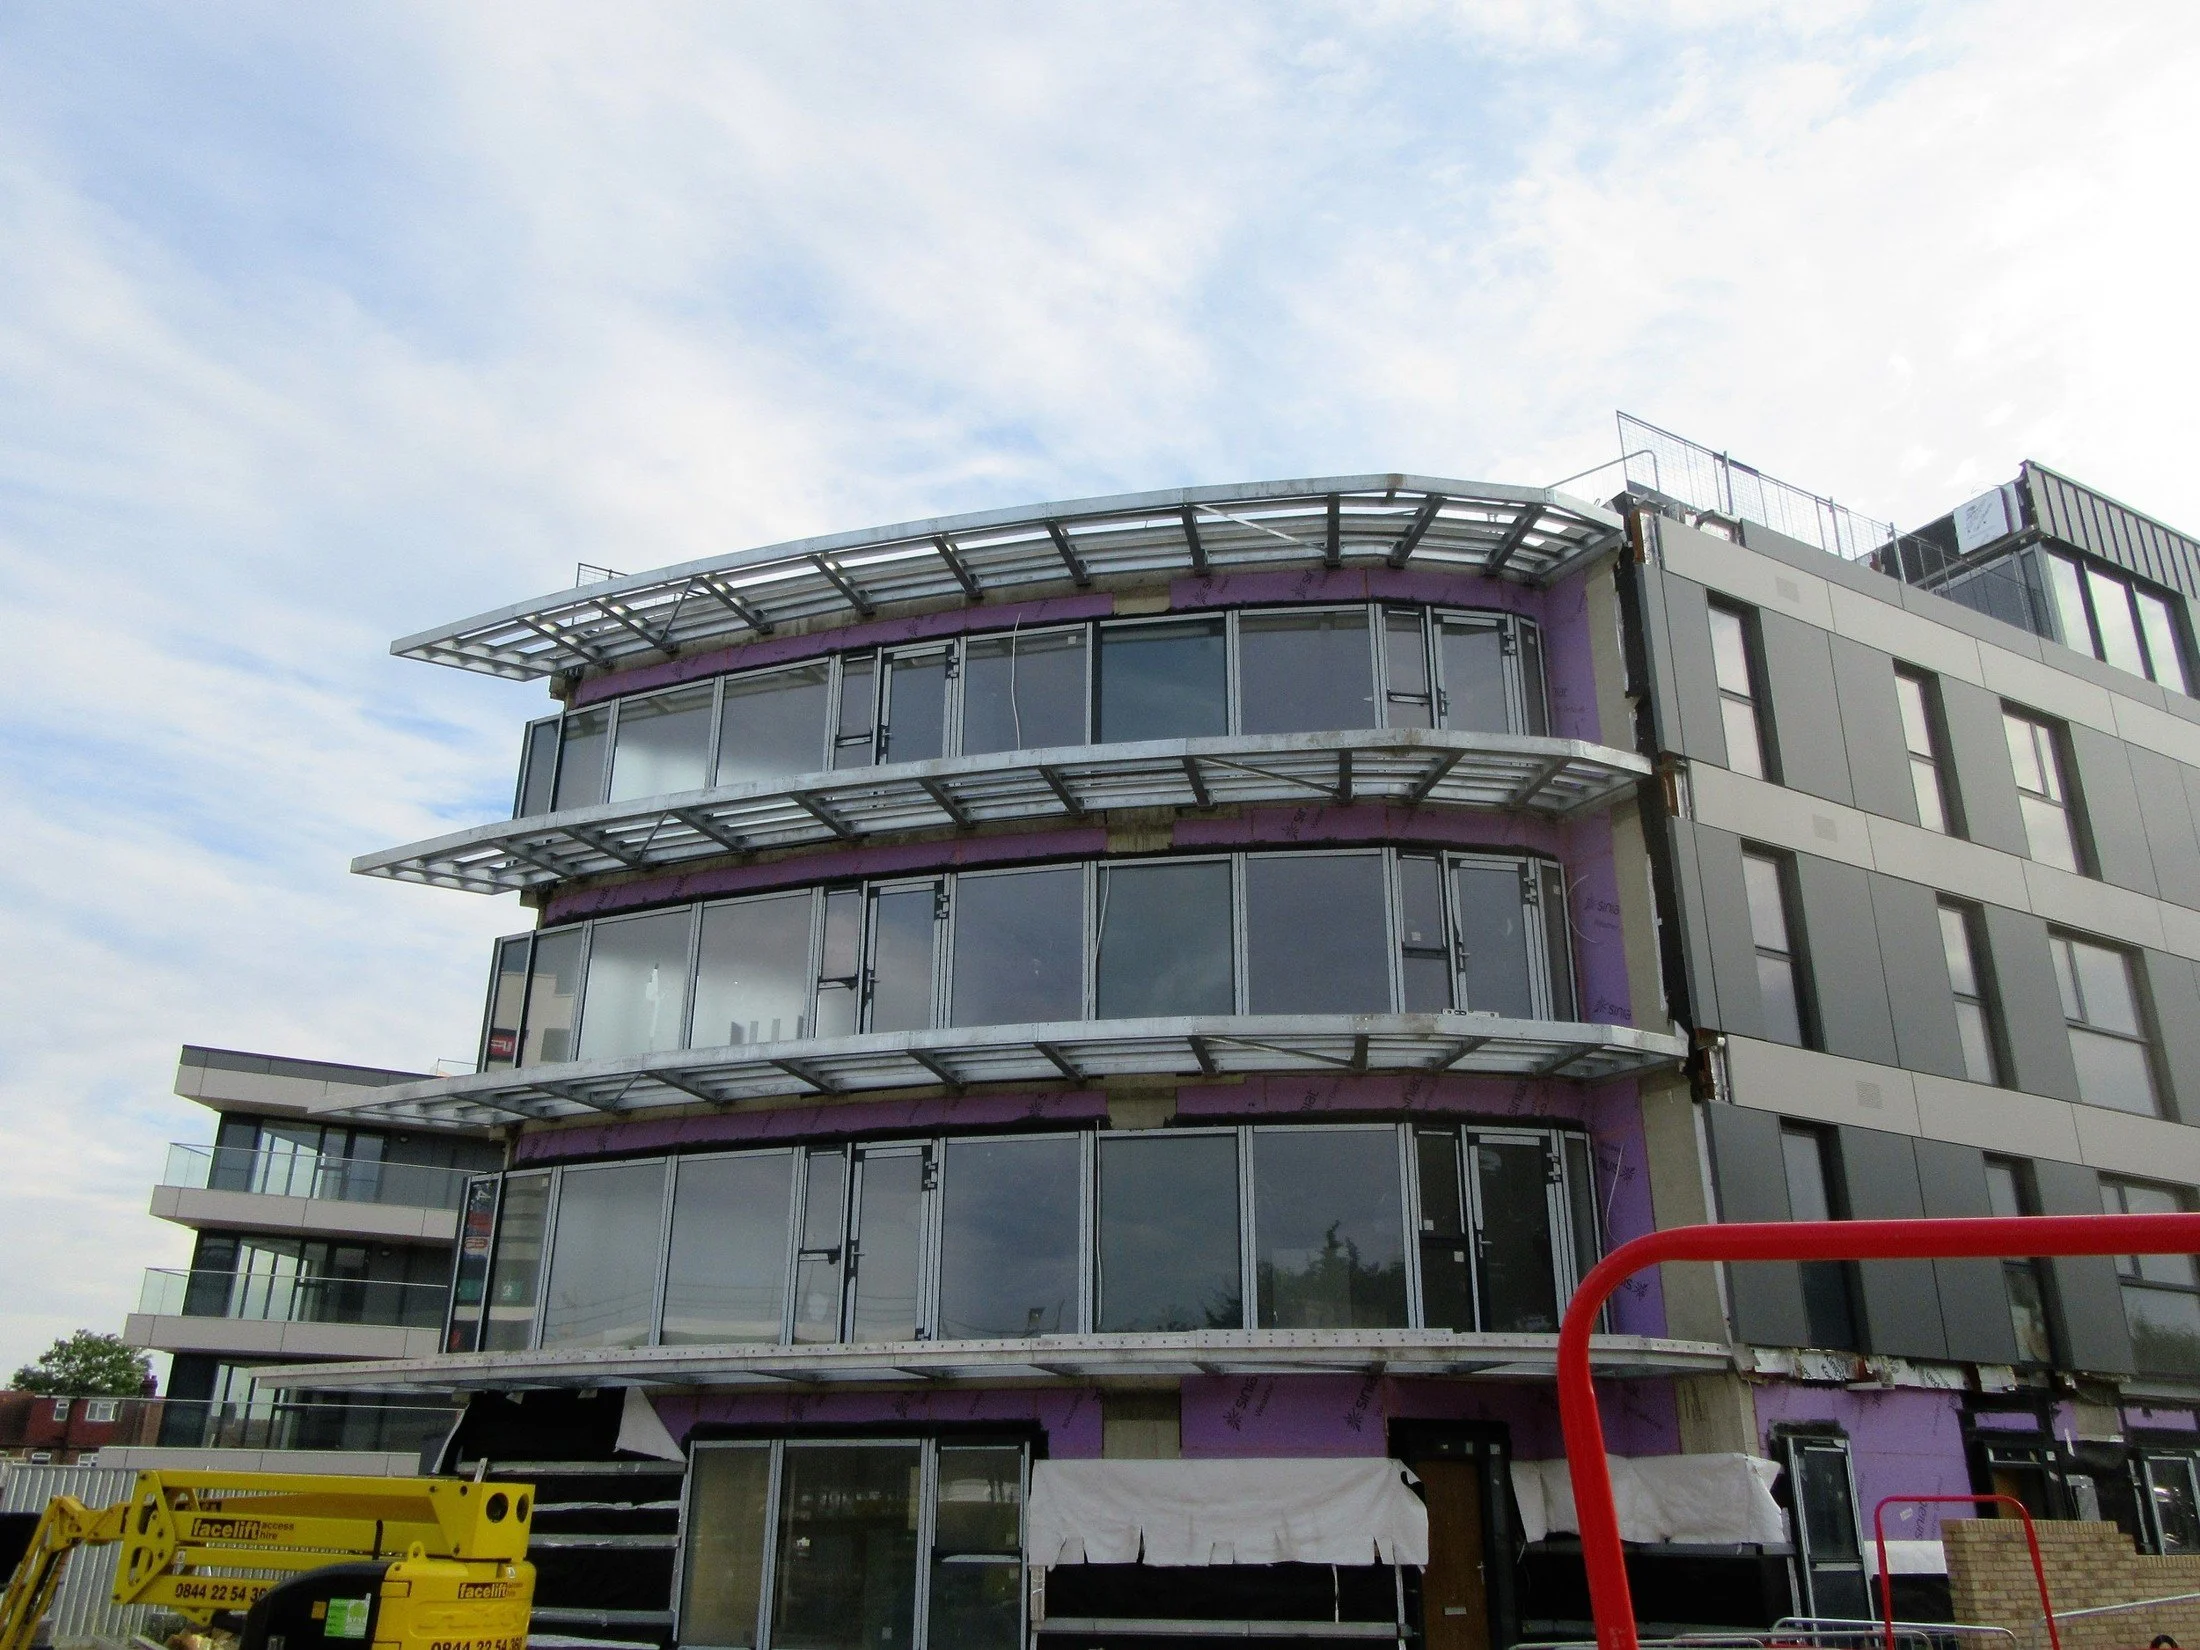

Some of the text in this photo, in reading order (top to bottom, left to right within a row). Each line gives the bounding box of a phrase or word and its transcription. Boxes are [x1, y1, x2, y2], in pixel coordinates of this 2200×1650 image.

[1235, 1374, 1259, 1410] sinia
[191, 1518, 295, 1540] facelift access
[260, 1531, 278, 1540] hire
[175, 1583, 208, 1599] 0844
[210, 1584, 228, 1601] 22
[230, 1586, 247, 1602] 54
[459, 1582, 508, 1599] facelift
